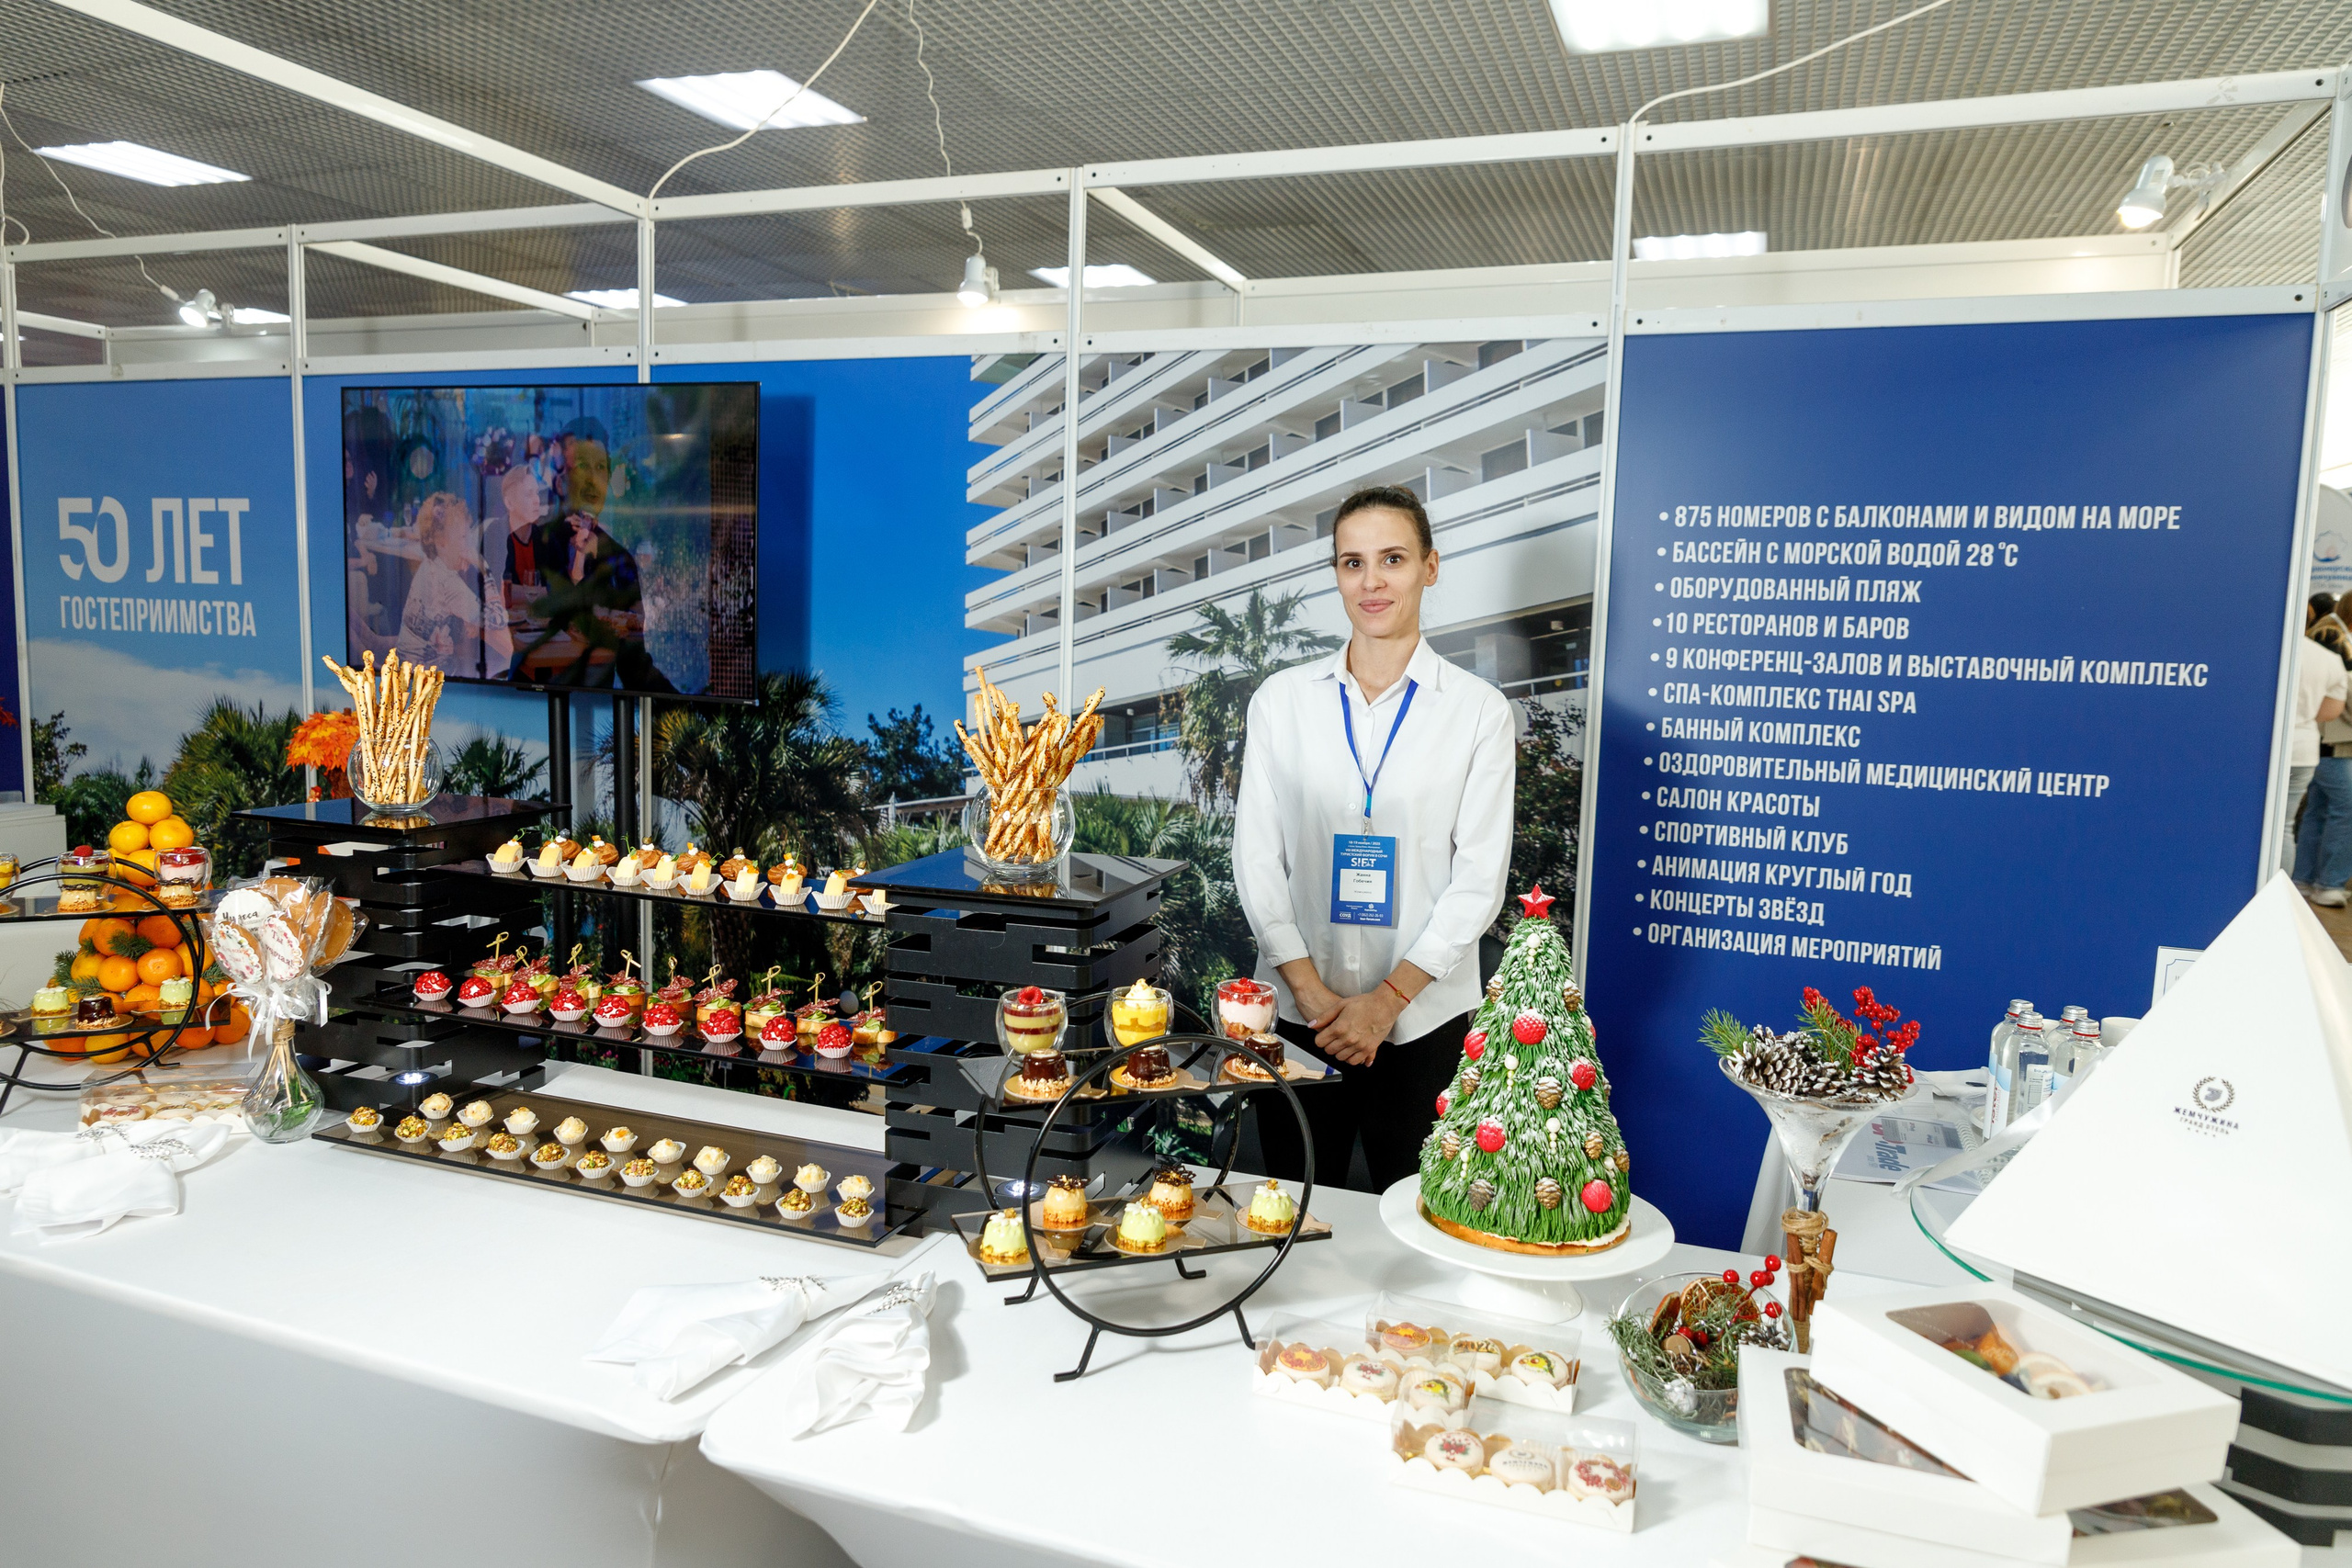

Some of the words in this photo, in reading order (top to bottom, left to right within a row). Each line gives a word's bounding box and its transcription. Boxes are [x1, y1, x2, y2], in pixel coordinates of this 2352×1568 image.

[1675, 505, 1713, 527] 875
[1717, 505, 1811, 527] НОМЕРОВ
[1816, 505, 1828, 527] С
[1835, 505, 1968, 528] БАЛКОНАМИ
[1973, 506, 1988, 528] И
[1995, 506, 2076, 531] ВИДОМ
[2082, 506, 2111, 528] НА
[2118, 506, 2181, 529] МОРЕ
[58, 496, 130, 583] 50
[146, 497, 250, 585] ЛЕТ
[1672, 538, 1761, 563] БАССЕЙН
[1767, 542, 1779, 564] С
[1784, 539, 1882, 565] МОРСКОЙ
[1887, 540, 1961, 568] ВОДОЙ
[1966, 543, 1995, 567] 28
[1670, 576, 1849, 602] ОБОРУДОВАННЫЙ
[1856, 580, 1922, 603] ПЛЯЖ
[60, 595, 256, 637] ГОСТЕПРИИМСТВА
[1666, 612, 1689, 634] 10
[1692, 613, 1818, 637] РЕСТОРАНОВ
[1824, 616, 1837, 637] И
[1843, 616, 1909, 639] БАРОВ
[1666, 648, 1679, 670] 9
[1682, 648, 1882, 675] КОНФЕРЕНЦ-ЗАЛОВ
[1888, 654, 1902, 676] И
[1907, 655, 2075, 682] ВЫСТАВОЧНЫЙ
[2080, 660, 2208, 686] КОМПЛЕКС
[1664, 682, 1820, 709] СПА-КОМПЛЕКС
[1826, 689, 1871, 711] THAI
[1878, 691, 1916, 713] SPA
[1661, 717, 1743, 741] БАННЫЙ
[1749, 721, 1860, 747] КОМПЛЕКС
[1659, 752, 1860, 784] ОЗДОРОВИТЕЛЬНЫЙ
[1866, 763, 2031, 793] МЕДИЦИНСКИЙ
[2038, 773, 2109, 797] ЦЕНТР
[1657, 787, 1722, 810] САЛОН
[1727, 791, 1819, 817] КРАСОТЫ
[1655, 821, 1785, 850] СПОРТИВНЫЙ
[1792, 830, 1848, 854] КЛУБ
[1653, 856, 1759, 884] АНИМАЦИЯ
[1766, 864, 1865, 891] КРУГЛЫЙ
[1871, 872, 1911, 897] ГОД
[1650, 889, 1753, 918] КОНЦЕРТЫ
[1759, 897, 1824, 926] ЗВЁЗД
[1647, 923, 1786, 955] ОРГАНИЗАЦИЯ
[1792, 936, 1941, 970] МЕРОПРИЯТИЙ
[2173, 1106, 2239, 1129] ЖЕМЧУЖИНА
[1875, 1142, 1910, 1172] Trade
